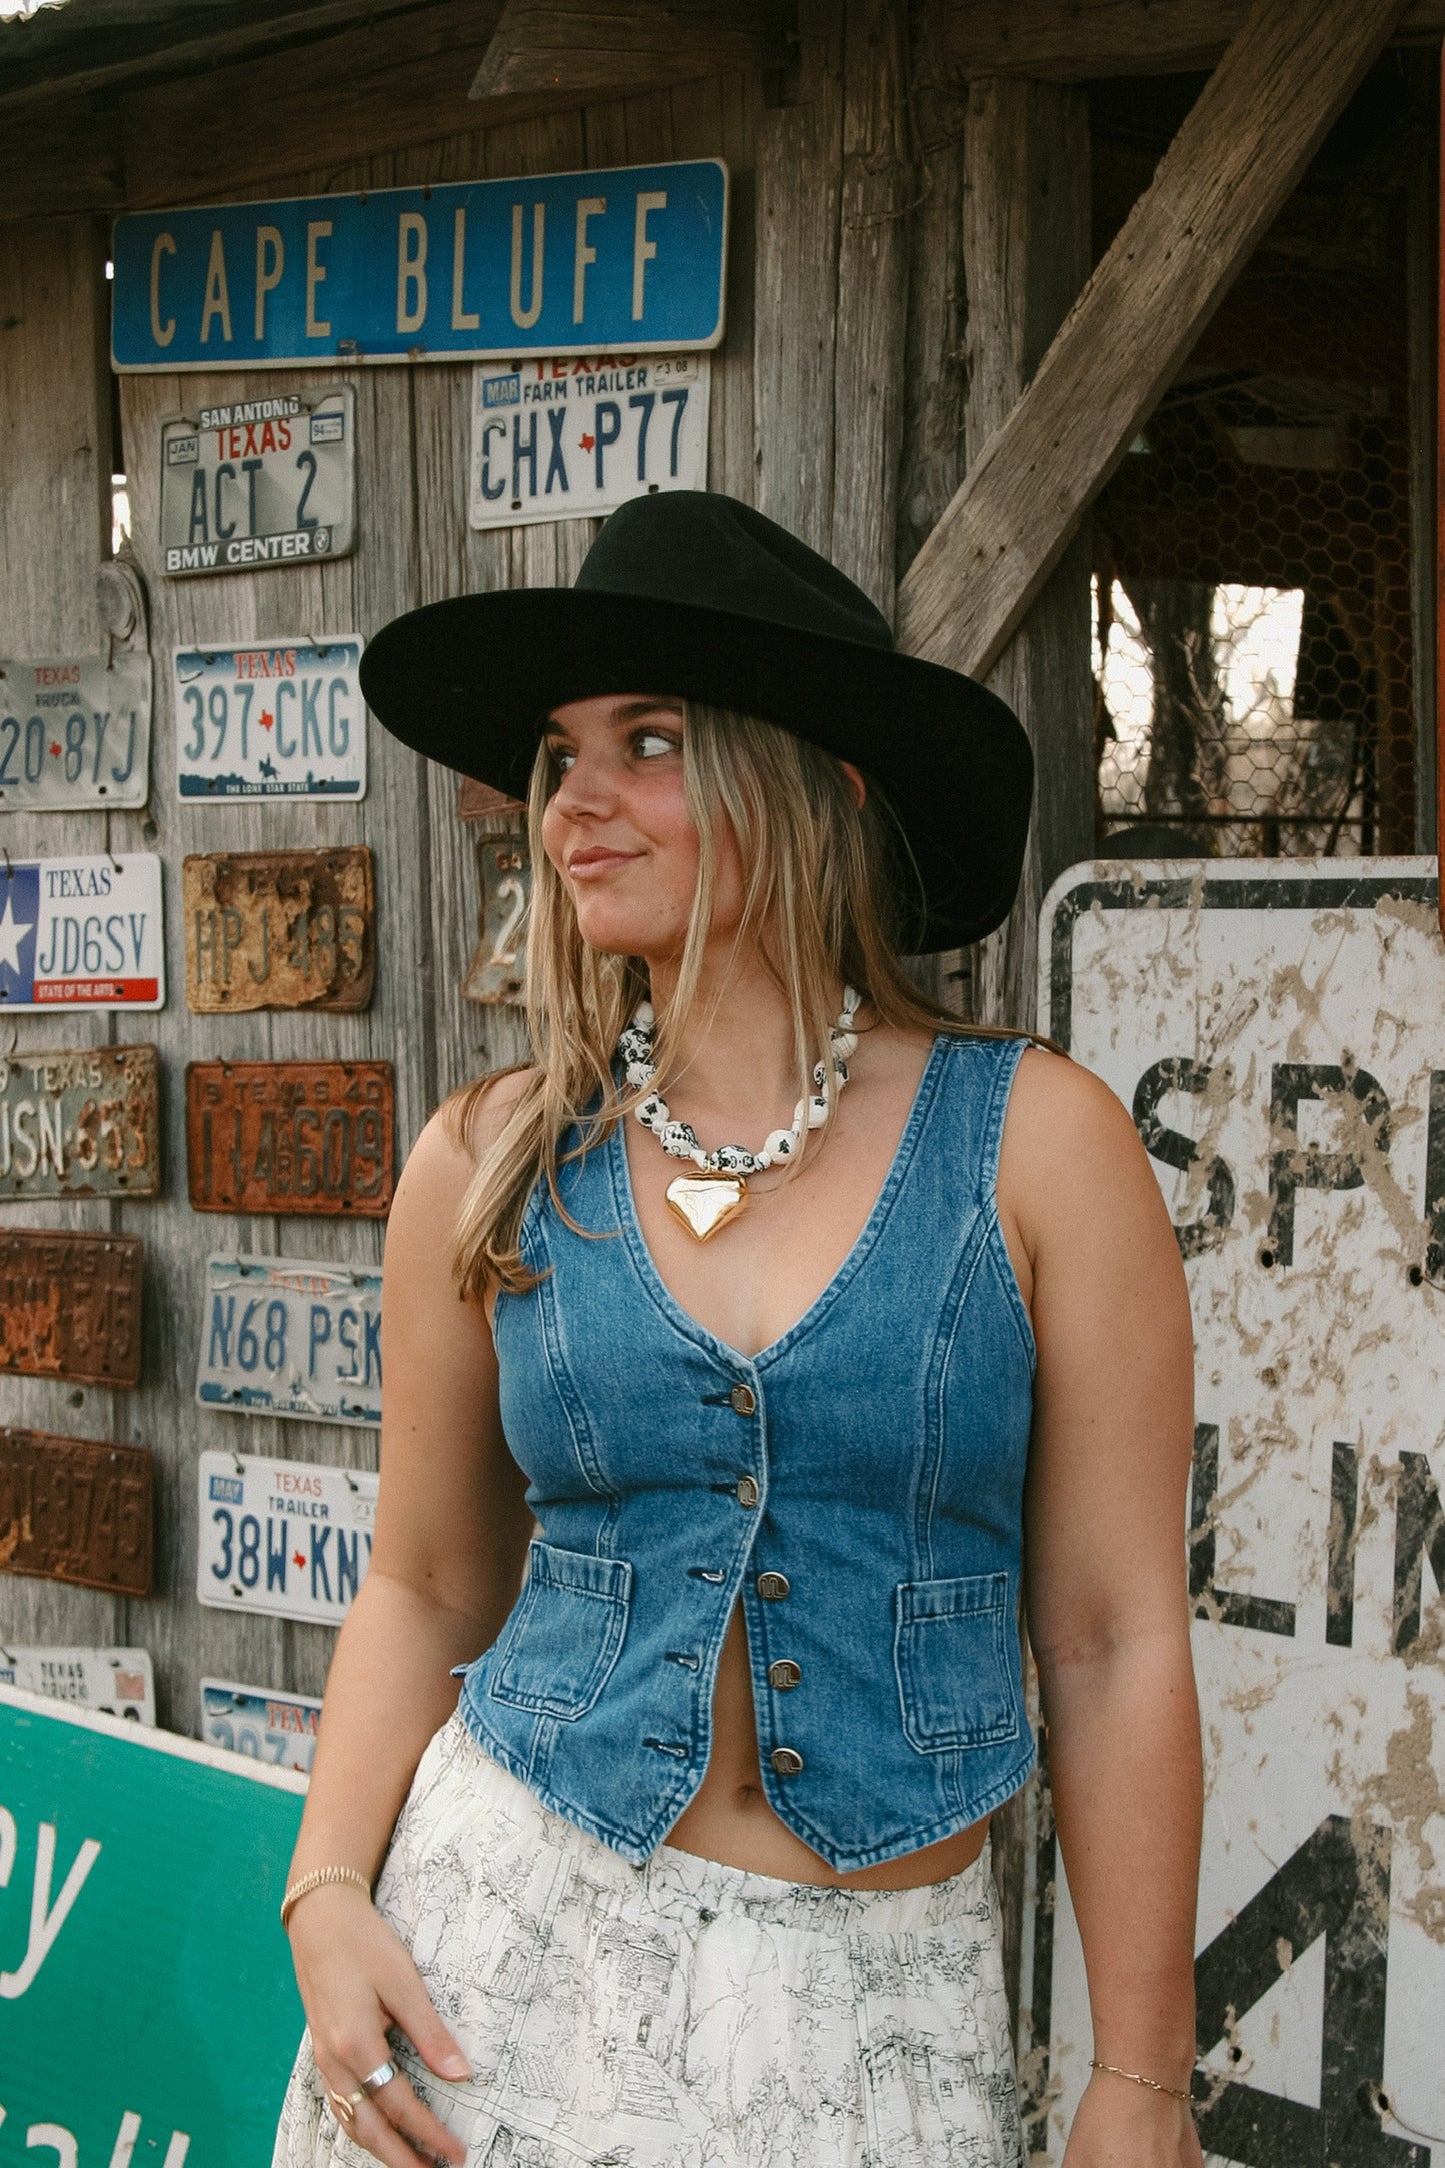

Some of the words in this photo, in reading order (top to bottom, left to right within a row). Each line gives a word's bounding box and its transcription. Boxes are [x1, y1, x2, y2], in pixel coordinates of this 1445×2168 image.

[149, 221, 333, 347] CAPE
[396, 190, 668, 334] BLUFF
[524, 381, 567, 403] FARM
[575, 369, 647, 397] TRAILER
[201, 410, 231, 429] SAN
[233, 396, 299, 424] ANTONIO
[170, 439, 196, 455] JAN
[215, 418, 292, 461] TEXAS
[481, 406, 569, 501] CHX
[595, 388, 689, 489] P77
[189, 459, 263, 543] ACT
[296, 450, 319, 529] 2
[166, 545, 218, 572] BMW
[226, 532, 310, 563] CENTER
[34, 665, 80, 686] TEXAS
[233, 650, 296, 680] TEXAS
[183, 683, 254, 762] 397
[275, 677, 350, 758] CKG
[46, 866, 112, 899] TEXAS
[39, 912, 147, 975] JD6SV
[29, 1057, 103, 1092] TEXAS
[208, 1295, 288, 1372] N68
[274, 1471, 322, 1497] TEXAS
[268, 1496, 329, 1520] TRAILER
[211, 1507, 288, 1594] 38W
